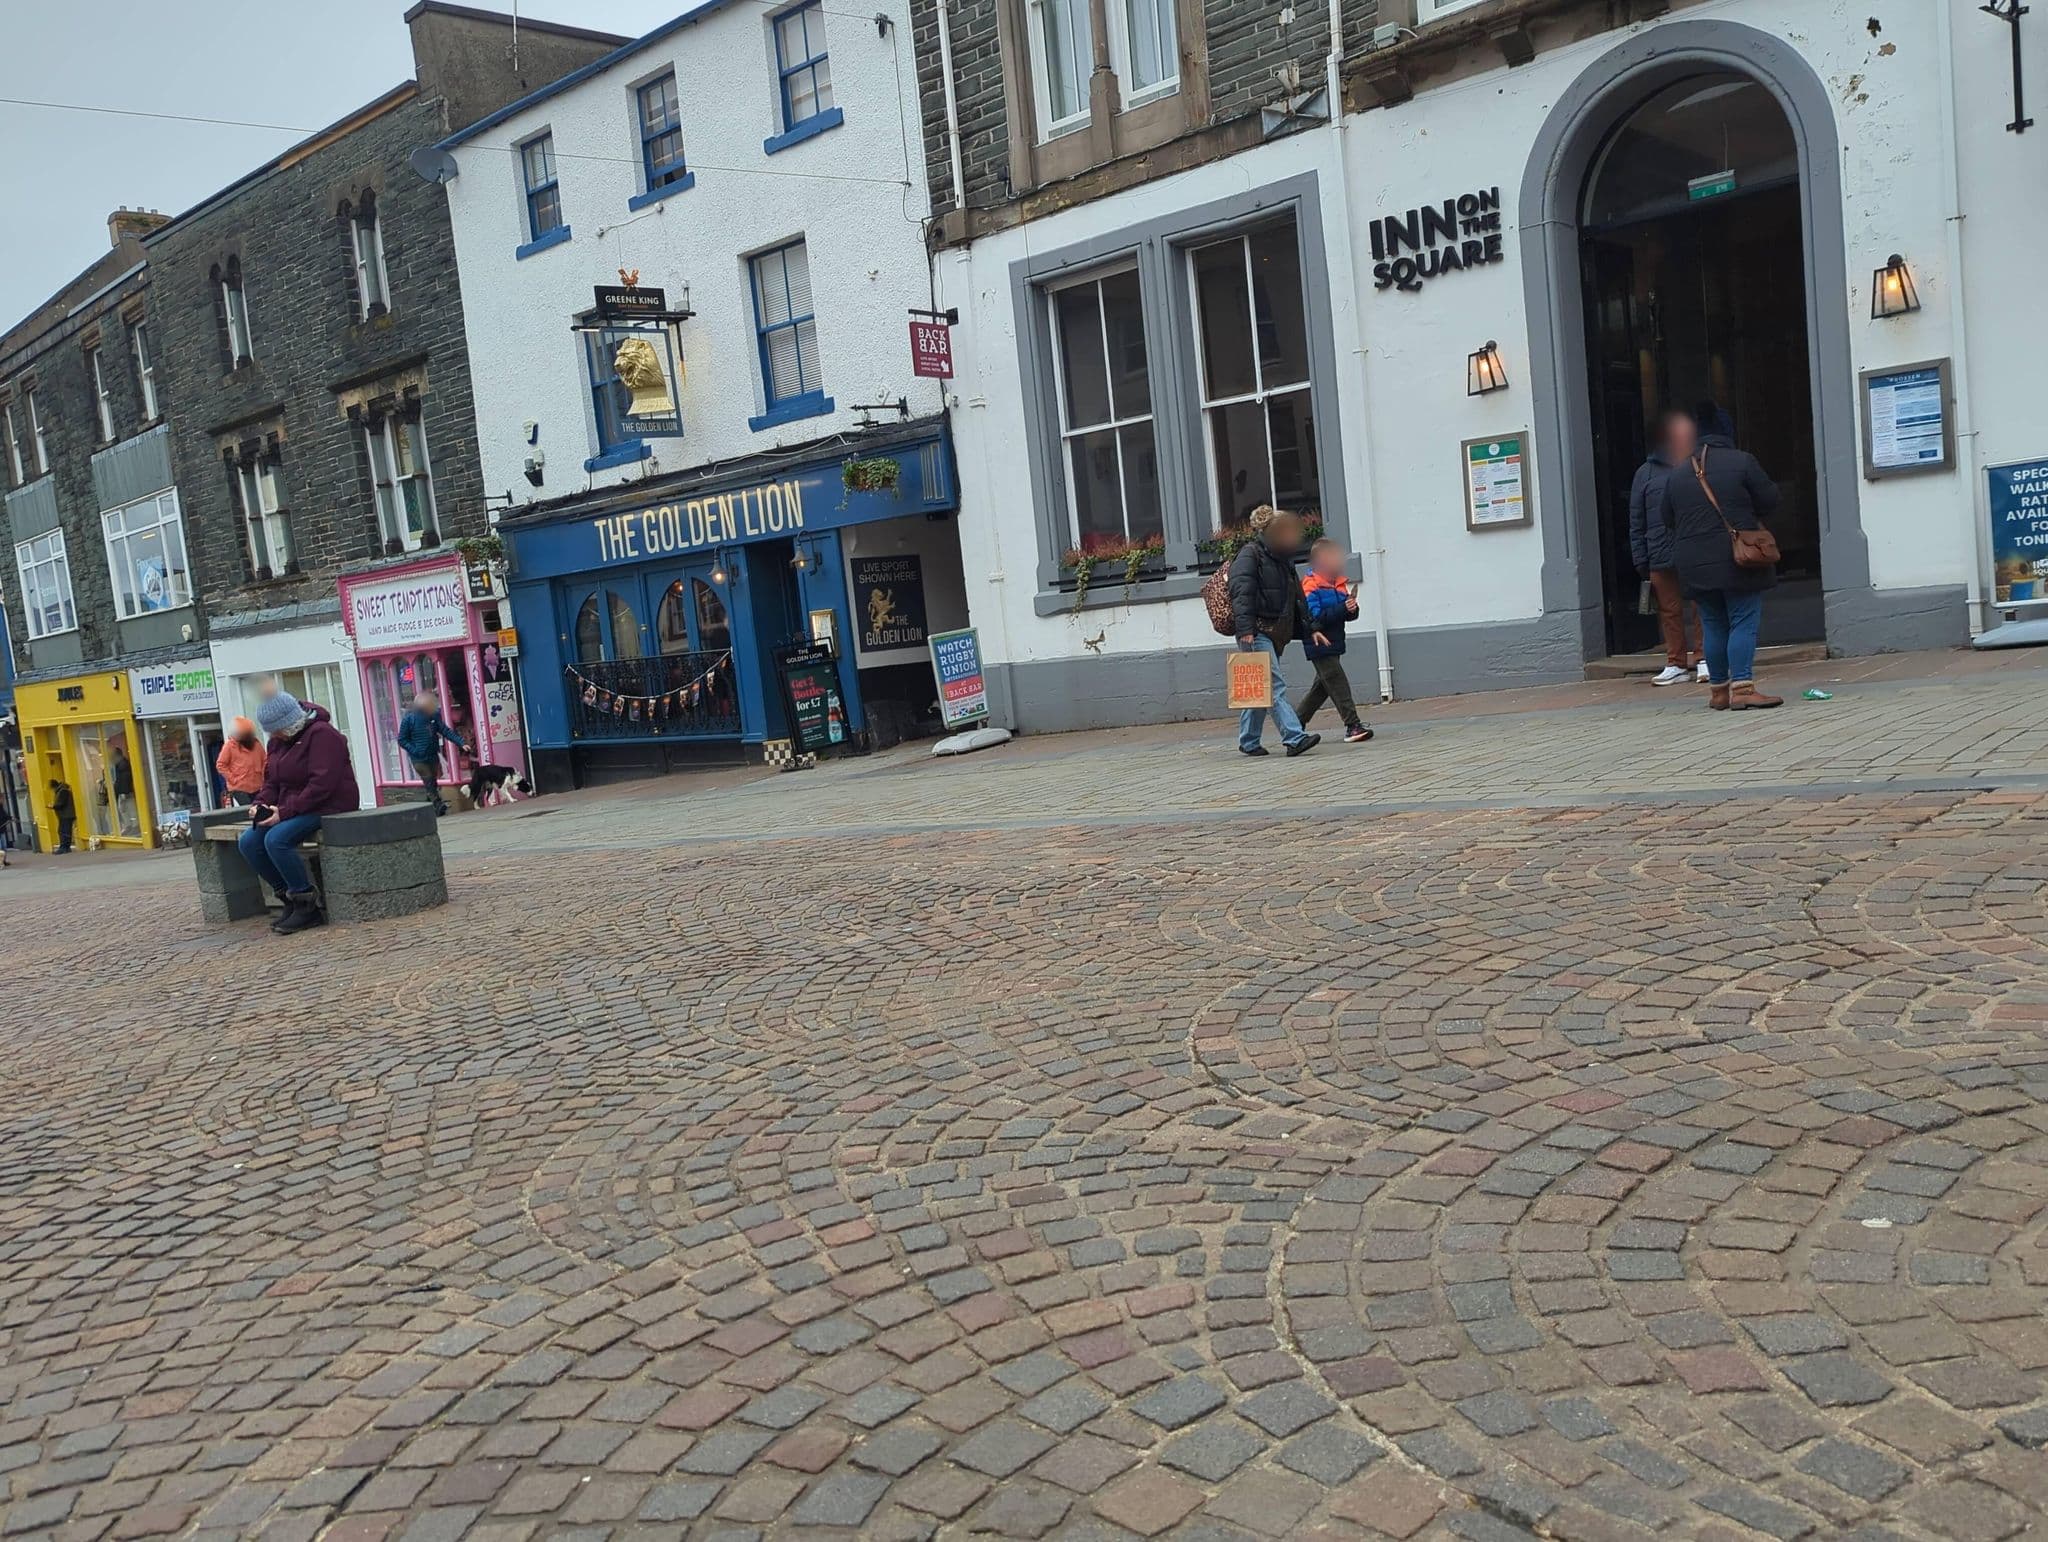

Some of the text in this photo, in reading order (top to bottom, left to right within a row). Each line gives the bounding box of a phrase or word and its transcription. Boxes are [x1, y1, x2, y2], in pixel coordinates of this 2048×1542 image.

[1457, 186, 1500, 216] ON
[1369, 198, 1458, 261] INN
[1459, 211, 1501, 237] THE
[1373, 233, 1504, 292] SQUARE
[605, 294, 660, 305] GREENE KING
[918, 327, 946, 341] BACK
[919, 338, 948, 355] BAR
[621, 420, 678, 433] THE GOLDEN LION
[594, 479, 804, 562] THE GOLDEN LION
[862, 560, 910, 573] LIVE SPORT
[858, 570, 918, 584] SHOWN HERE
[357, 583, 462, 621] SWEET TEMPTATIONS
[398, 622, 418, 632] FUDGE
[423, 618, 434, 628] ICE
[434, 615, 455, 627] CREAM
[896, 614, 910, 626] THE
[866, 627, 922, 646] GOLDEN LION
[937, 638, 973, 655] WATCH
[786, 655, 809, 664] GOLDEN
[809, 652, 823, 660] LION
[940, 649, 975, 666] RUGBY
[943, 660, 977, 676] UNION
[1233, 665, 1264, 675] BOOKS
[141, 669, 213, 695] TEMPLE SPORTS
[488, 690, 514, 702] CREA
[1233, 682, 1264, 700] BAG
[796, 698, 821, 712] for £7
[480, 720, 491, 764] FLOS
